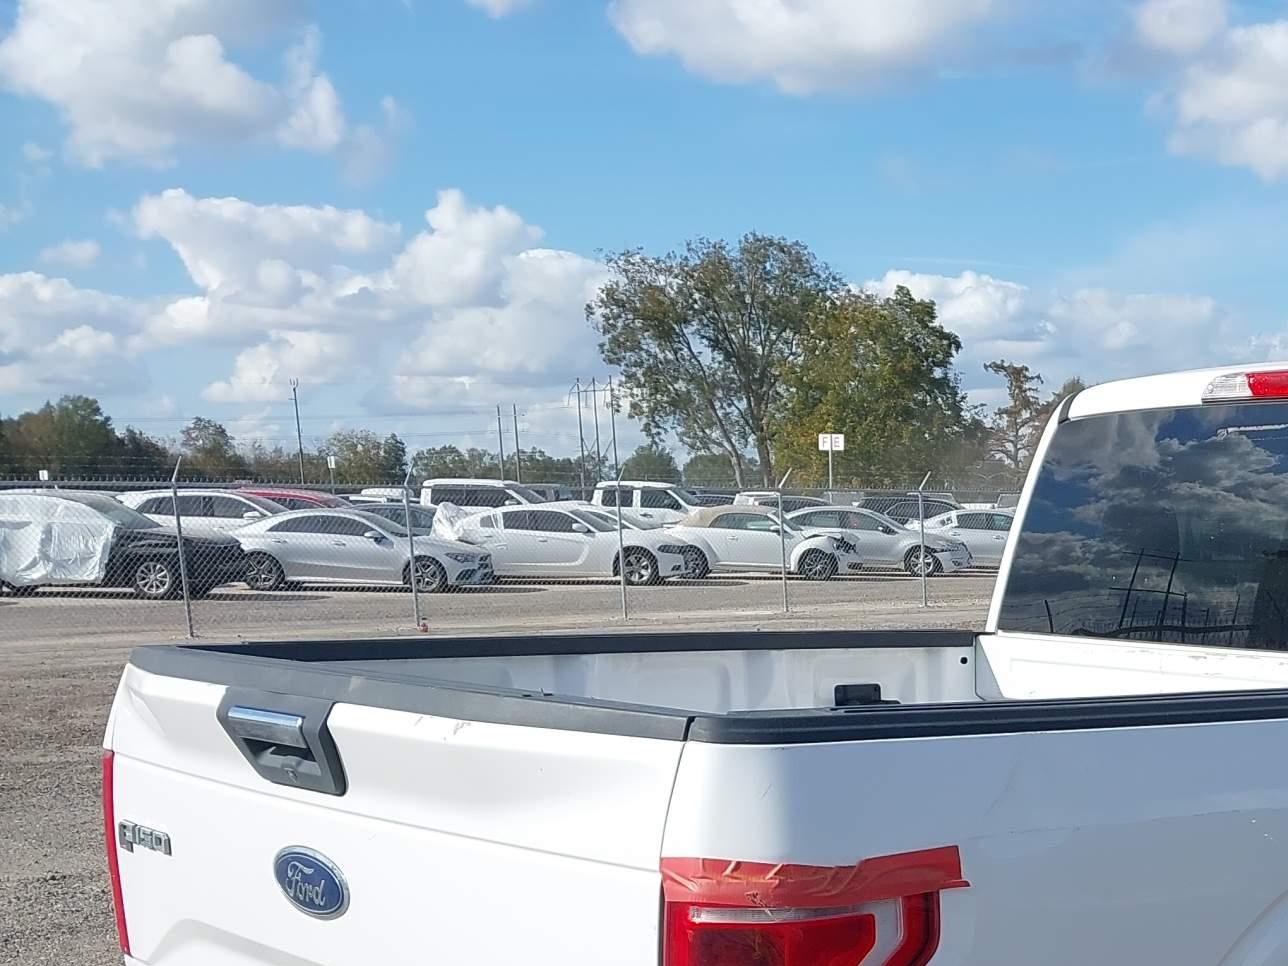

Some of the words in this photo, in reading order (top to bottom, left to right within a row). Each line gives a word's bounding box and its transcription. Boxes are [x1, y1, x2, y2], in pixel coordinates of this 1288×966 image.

[822, 436, 829, 449] F
[833, 436, 841, 448] E
[285, 860, 326, 907] Ford
